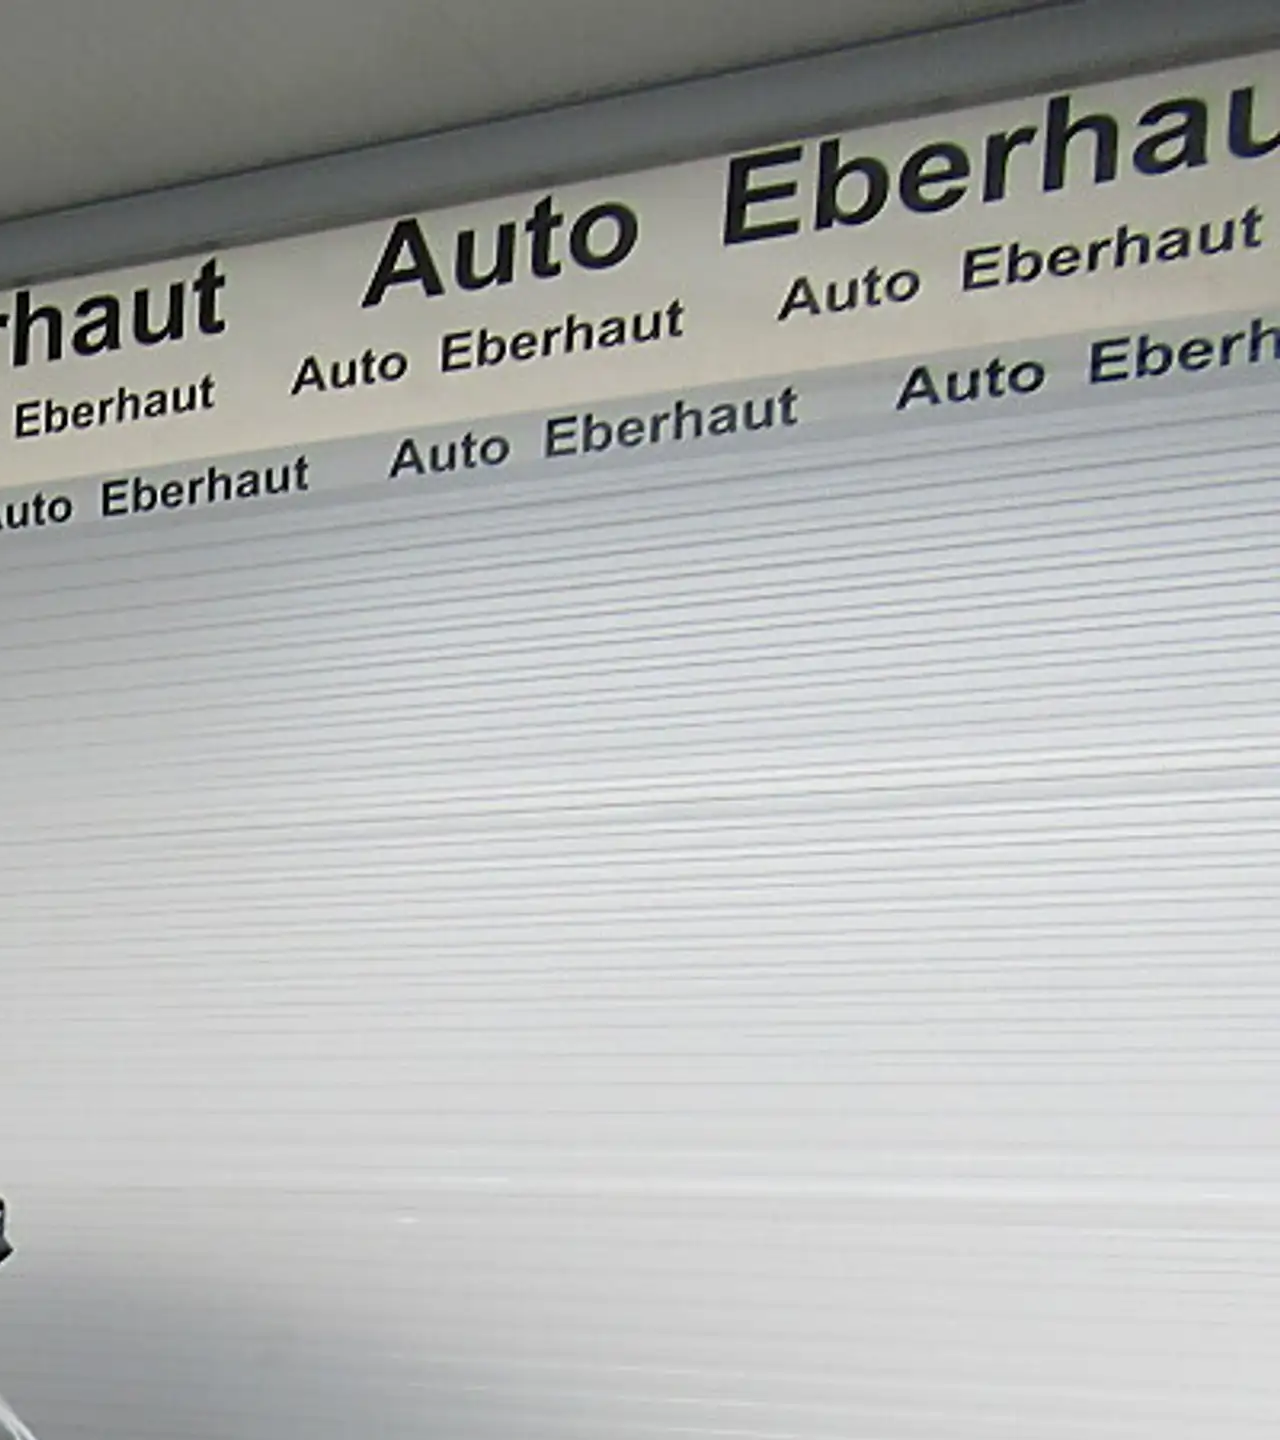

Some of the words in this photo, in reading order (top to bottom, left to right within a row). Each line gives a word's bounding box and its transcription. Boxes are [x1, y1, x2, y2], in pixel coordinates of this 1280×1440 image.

[361, 195, 638, 309] Auto
[723, 87, 1280, 247] Eberhau
[777, 266, 921, 322] Auto
[962, 204, 1264, 293] Eberhaut
[290, 344, 408, 396] Auto
[441, 298, 685, 373] Eberhaut
[895, 357, 1046, 411] Auto
[15, 374, 215, 439] Eberhaut
[388, 431, 510, 479] Auto
[545, 385, 798, 459] Eberhaut
[101, 454, 309, 517] Eberhaut
